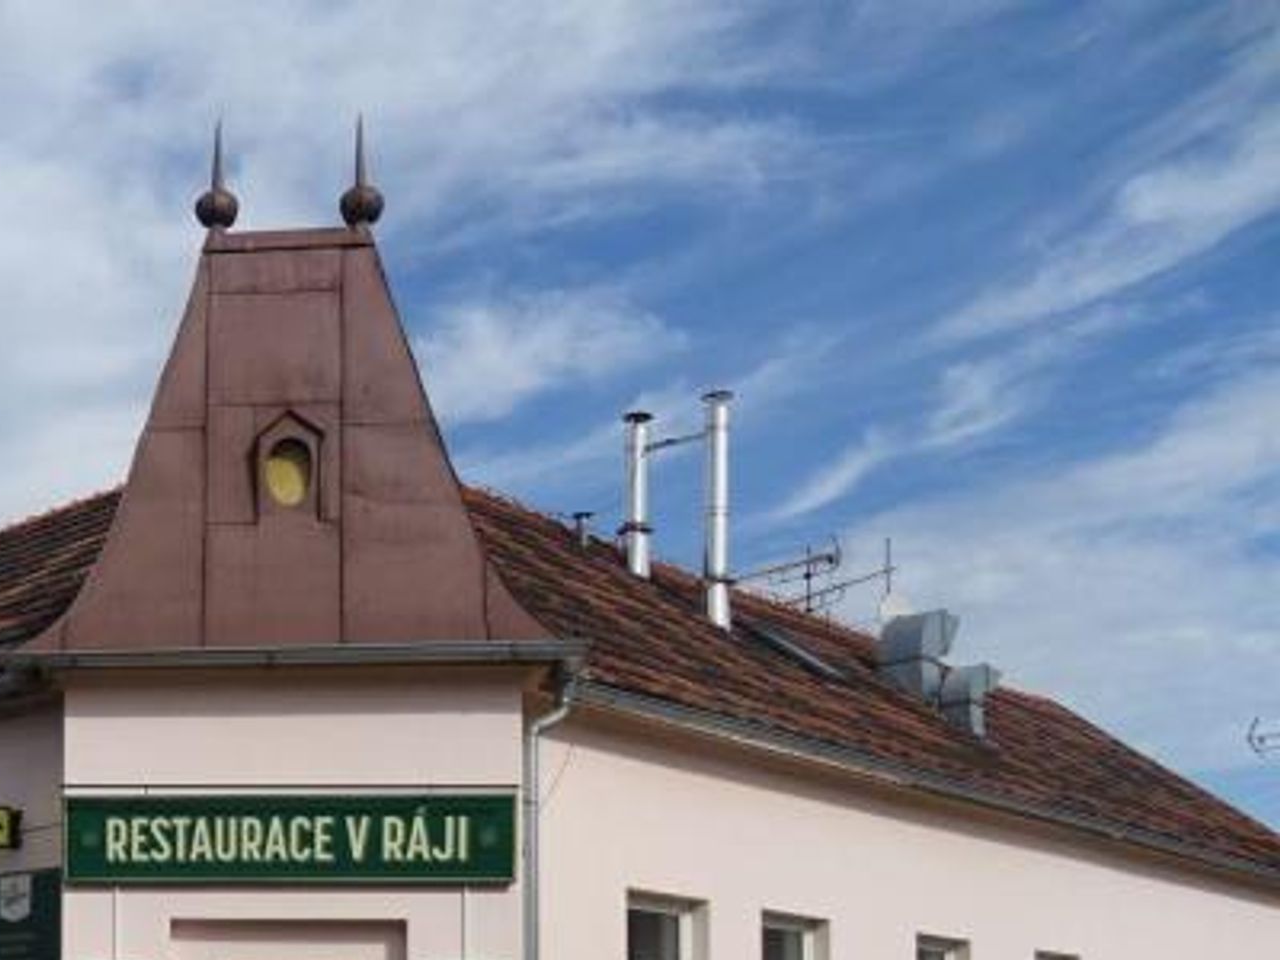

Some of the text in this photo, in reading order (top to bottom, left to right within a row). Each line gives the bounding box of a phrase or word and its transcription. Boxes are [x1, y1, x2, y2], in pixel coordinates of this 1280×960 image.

[105, 806, 470, 863] RESTAURACE V RÁJI
